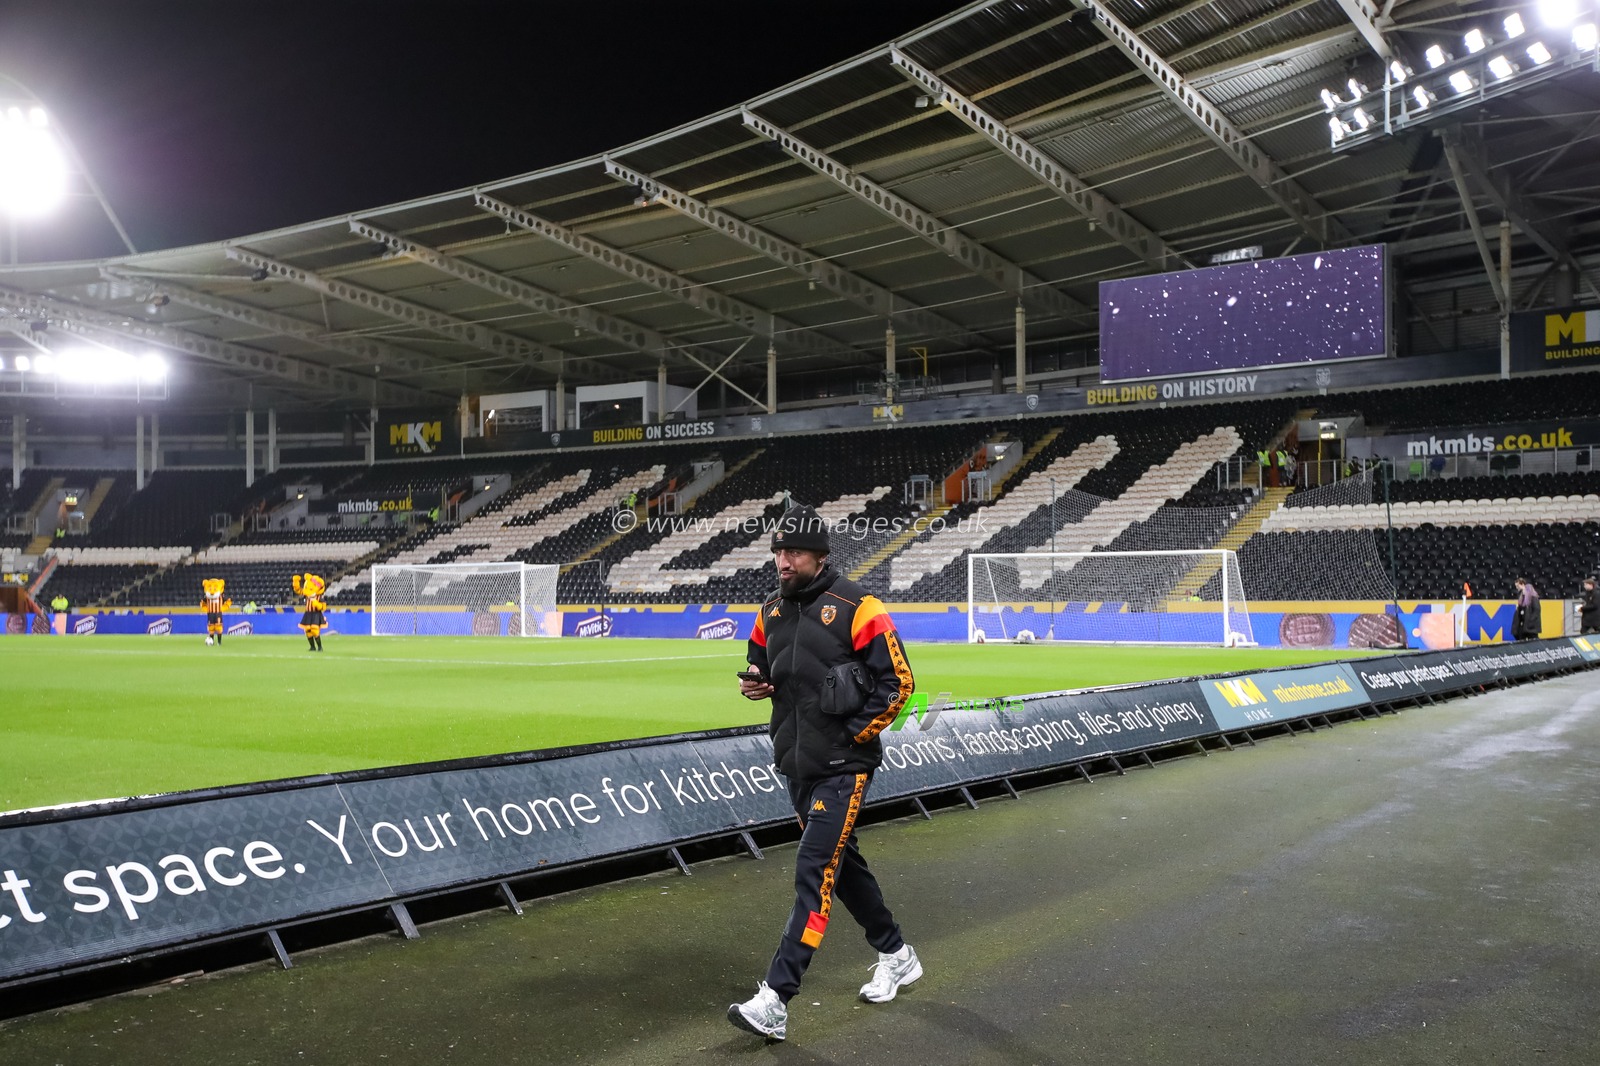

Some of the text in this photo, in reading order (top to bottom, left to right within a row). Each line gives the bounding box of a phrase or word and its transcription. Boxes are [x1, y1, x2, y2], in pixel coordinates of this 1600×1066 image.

[1545, 309, 1600, 346] M
[1545, 347, 1600, 360] BUILDING
[1087, 375, 1258, 405] BUILDING ON HISTORY
[873, 404, 904, 422] MKM
[389, 421, 442, 453] MKM
[593, 421, 715, 444] BUILDING ON SUCCESS
[1407, 427, 1574, 457] mkmbs.co.uk
[338, 496, 413, 513] mkmbs.co.uk
[579, 620, 609, 637] McVities
[1213, 677, 1268, 708] MKM
[1272, 675, 1353, 704] mkmhome.co.uk
[1360, 671, 1395, 690] Create
[1243, 708, 1274, 722] HOME
[63, 840, 306, 921] space.
[461, 791, 601, 842] home
[601, 777, 663, 818] for
[952, 718, 1088, 757] landscaping,
[1077, 710, 1119, 737] tiles
[1117, 703, 1153, 730] and
[1147, 701, 1205, 733] joinery.
